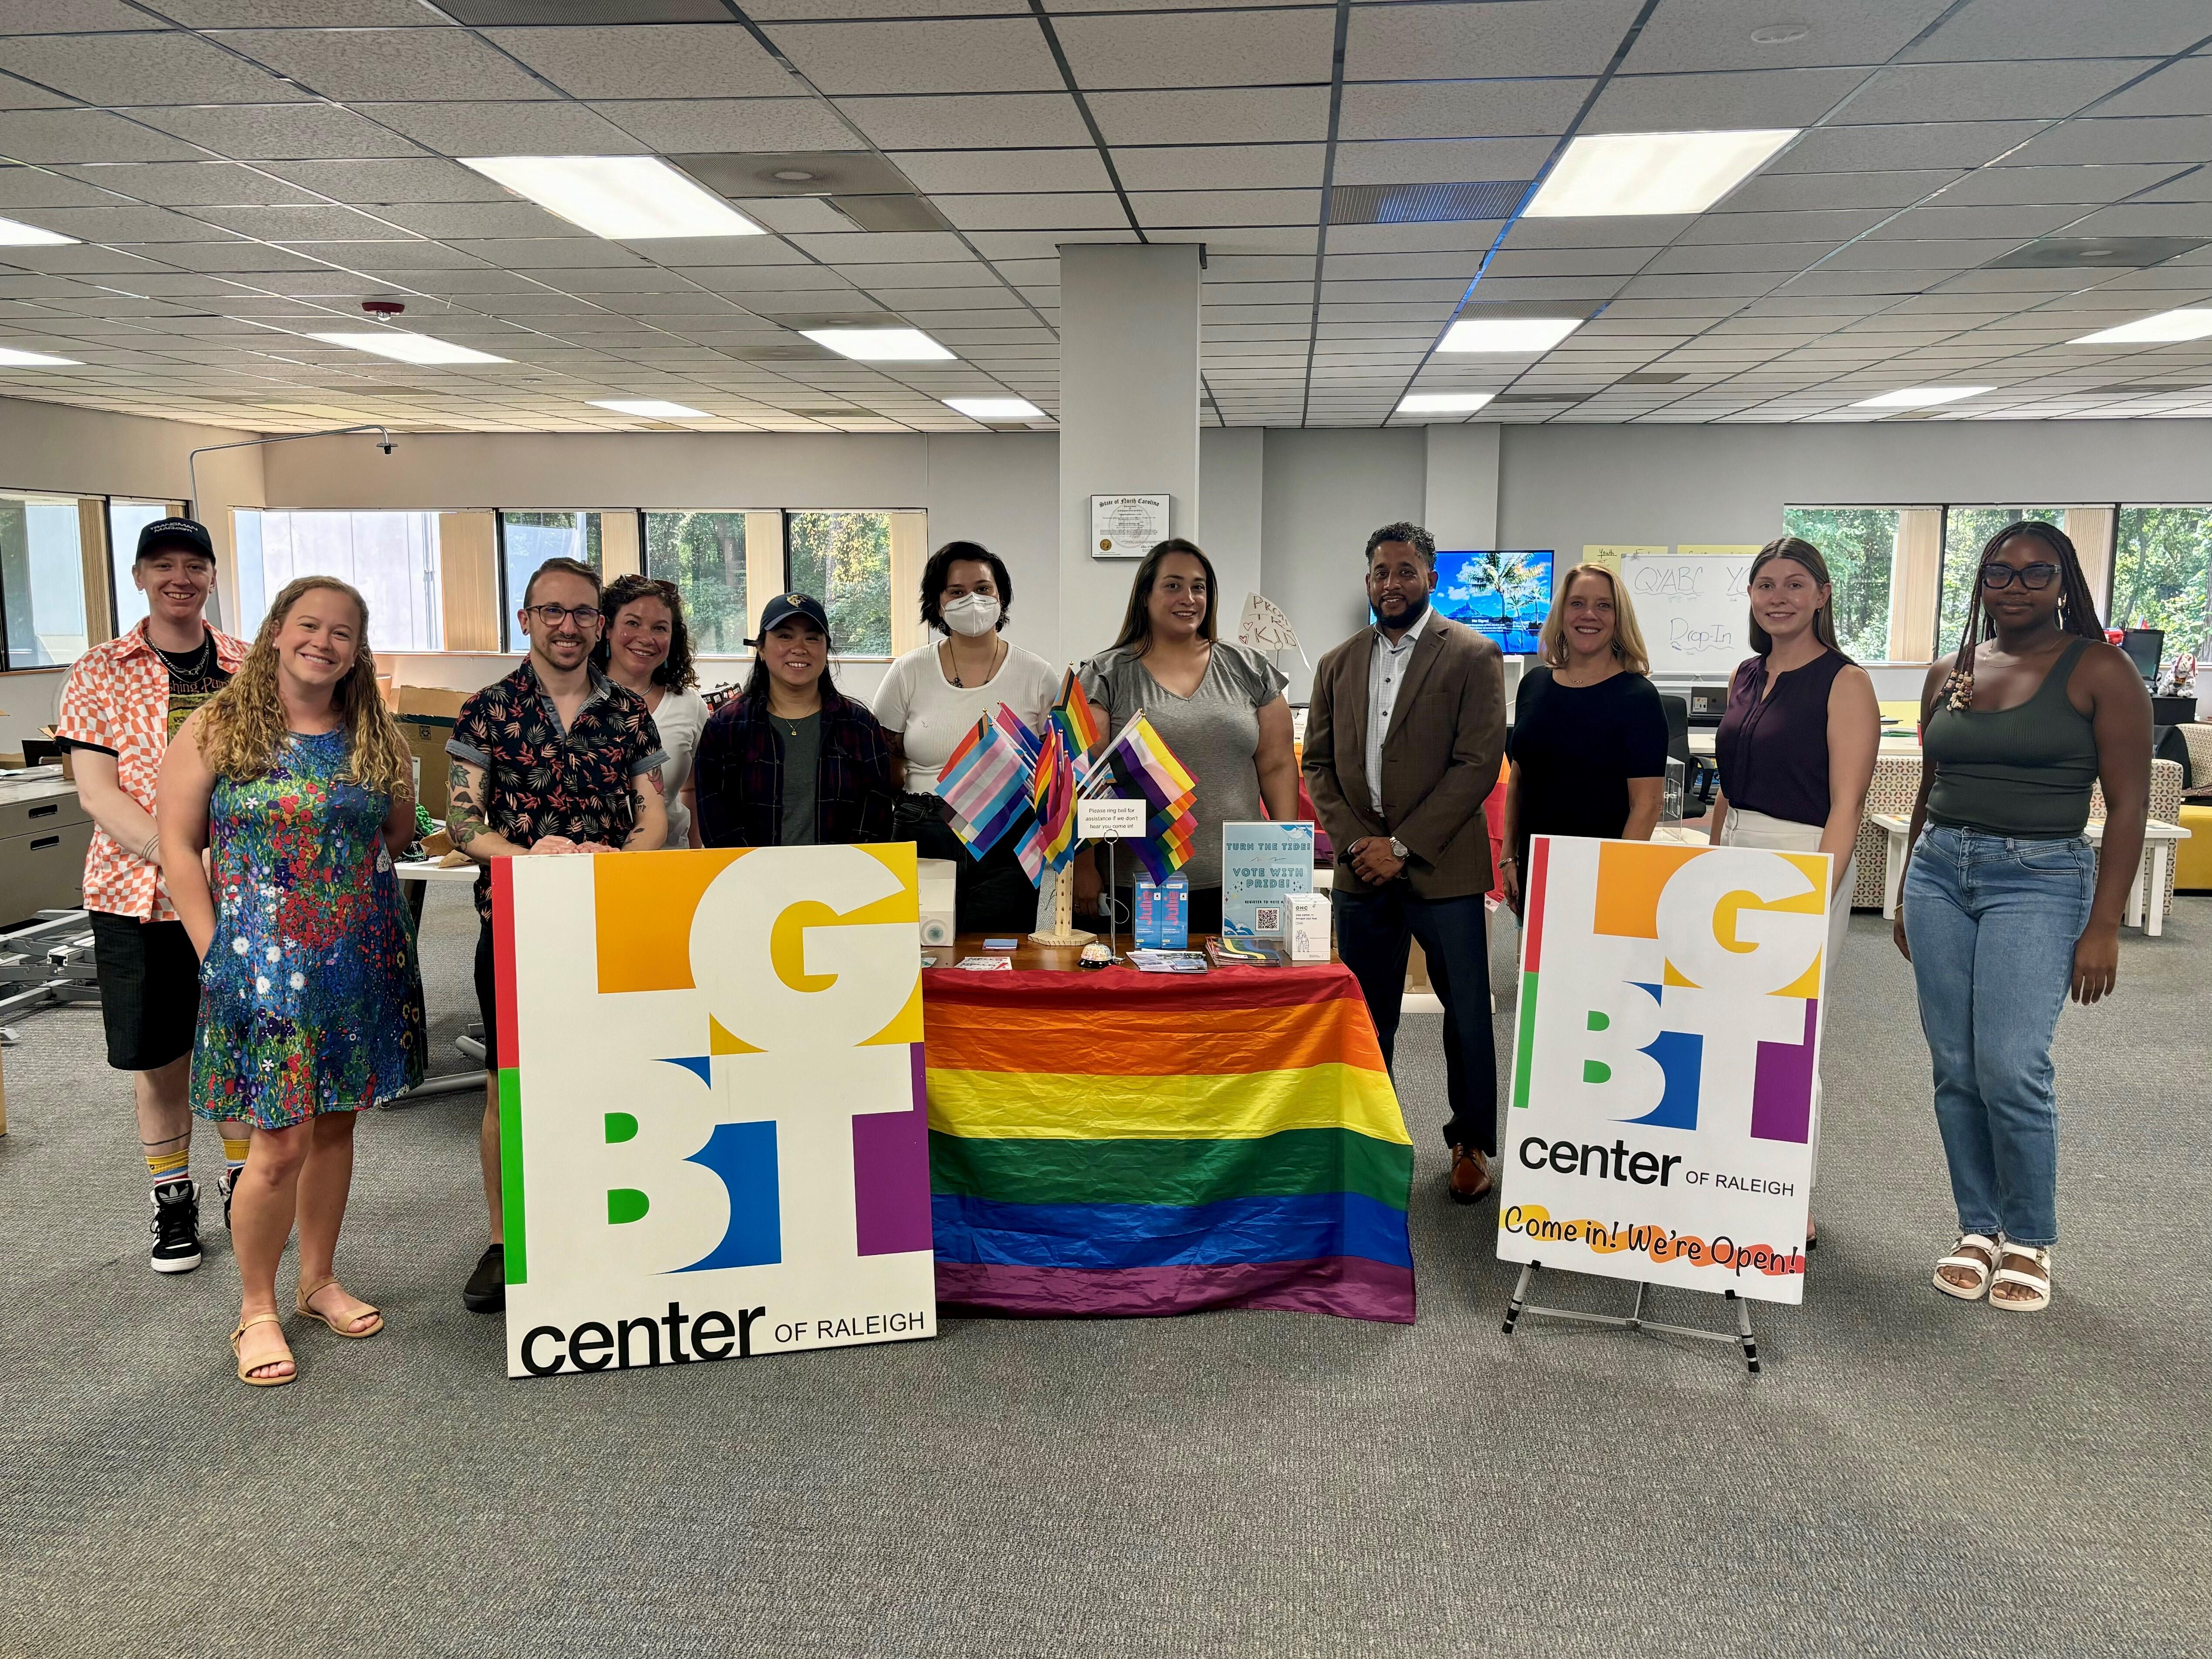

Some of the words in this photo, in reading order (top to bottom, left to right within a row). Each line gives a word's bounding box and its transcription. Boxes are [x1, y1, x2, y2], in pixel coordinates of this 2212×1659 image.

[1138, 498, 1159, 507] Carolina
[150, 522, 198, 531] TRANSMAN
[1599, 548, 1614, 558] Youth
[1634, 567, 1704, 593] QYABC
[1670, 617, 1731, 648] Drop-In
[1233, 868, 1265, 877] VOTE
[1270, 868, 1303, 877] WITH
[1246, 879, 1290, 888] PRIDE!
[1137, 891, 1153, 926] Julie
[1163, 891, 1179, 926] Julie
[1519, 1136, 1681, 1187] center
[1685, 1170, 1710, 1185] OF
[1715, 1175, 1794, 1197] RALEIGH
[1505, 1205, 1577, 1243] Come
[1586, 1221, 1620, 1249] in!
[1627, 1223, 1701, 1260] We're
[1711, 1236, 1798, 1277] Open!
[521, 1302, 766, 1376] center
[775, 1322, 808, 1343] OF
[817, 1311, 924, 1340] RALEIGH
